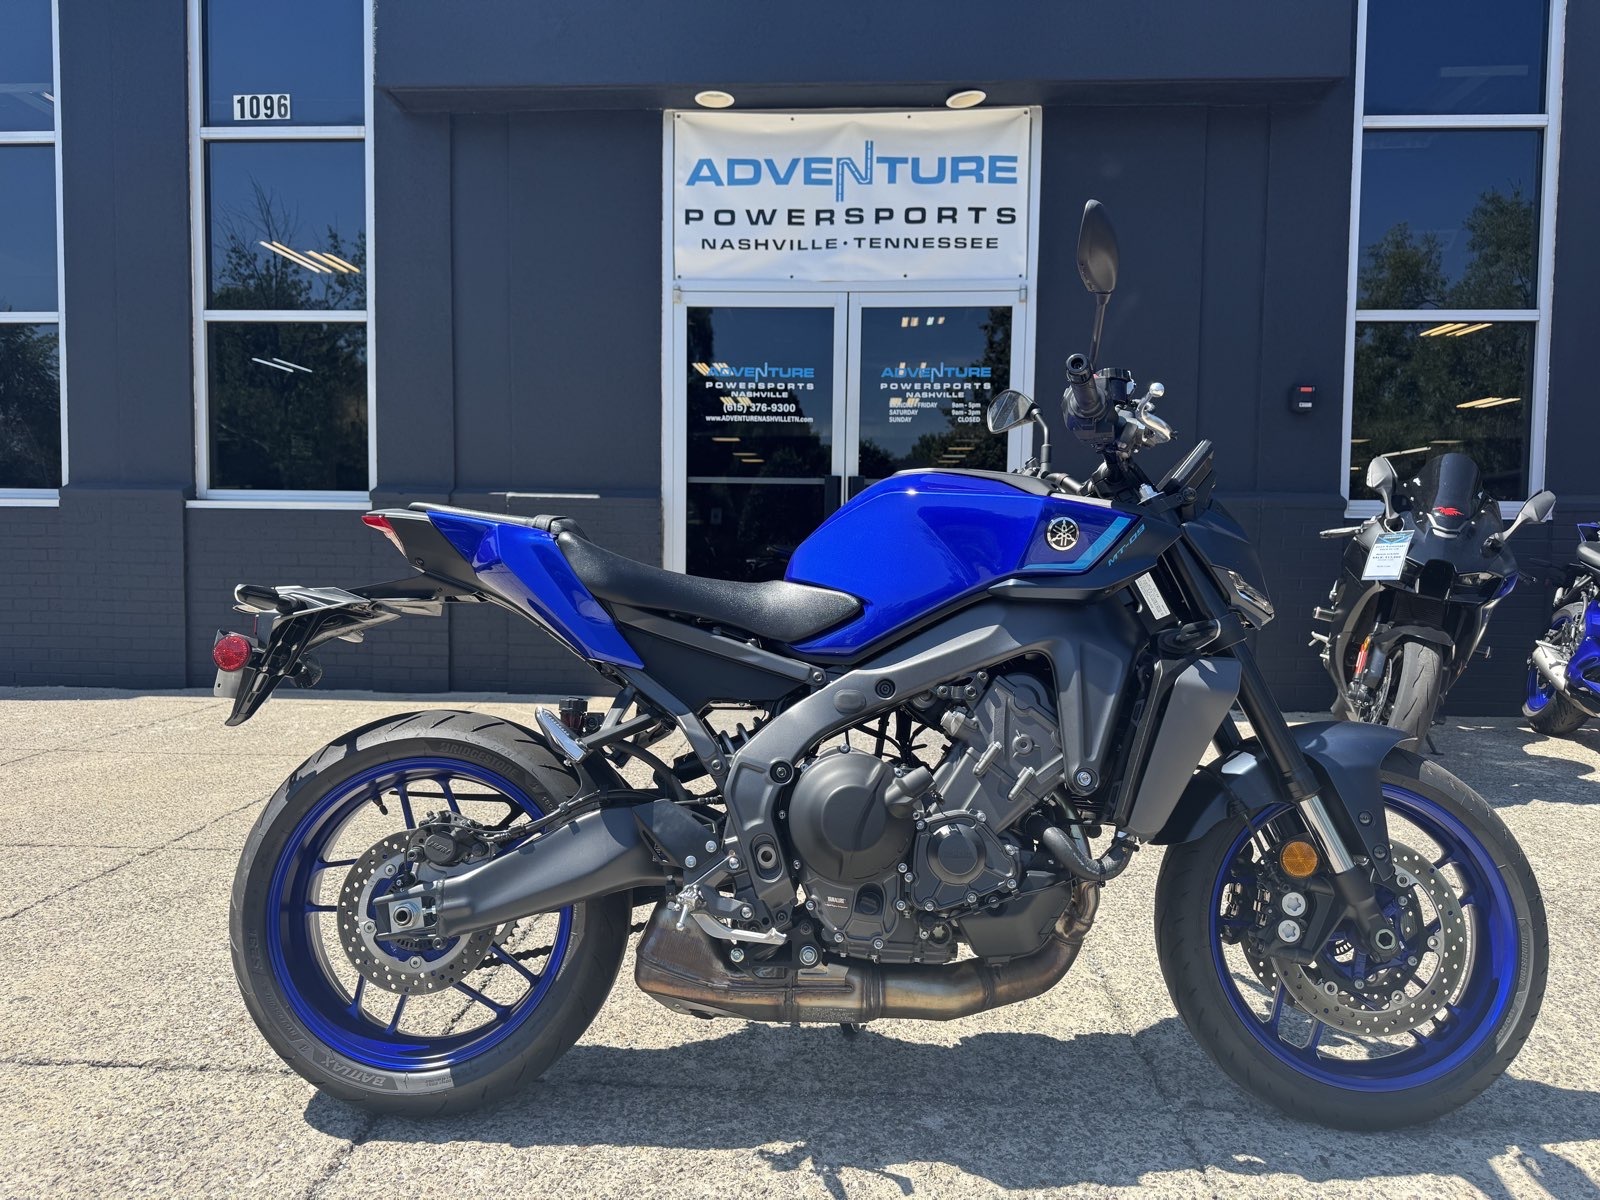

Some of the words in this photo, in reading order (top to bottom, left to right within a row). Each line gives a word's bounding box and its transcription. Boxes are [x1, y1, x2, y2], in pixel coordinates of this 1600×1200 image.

[236, 94, 289, 119] 1096
[685, 140, 1018, 202] ADVENTURE
[684, 206, 1017, 226] POWERSPORTS
[701, 237, 838, 251] NASHVILLE
[853, 236, 999, 250] TENNESSEE
[706, 362, 815, 382] ADVENTURE
[880, 362, 992, 383] ADVENTURE
[705, 381, 815, 390] POWERSPORTS
[730, 391, 789, 399] NASHVILLE
[880, 382, 992, 390] POWERSPORTS
[905, 391, 965, 399] NASHVILLE
[750, 403, 796, 413] 376-9300
[1107, 523, 1146, 566] MT-09
[439, 741, 521, 776] BRIDGESTONE
[319, 1053, 388, 1088] BATTLAX
